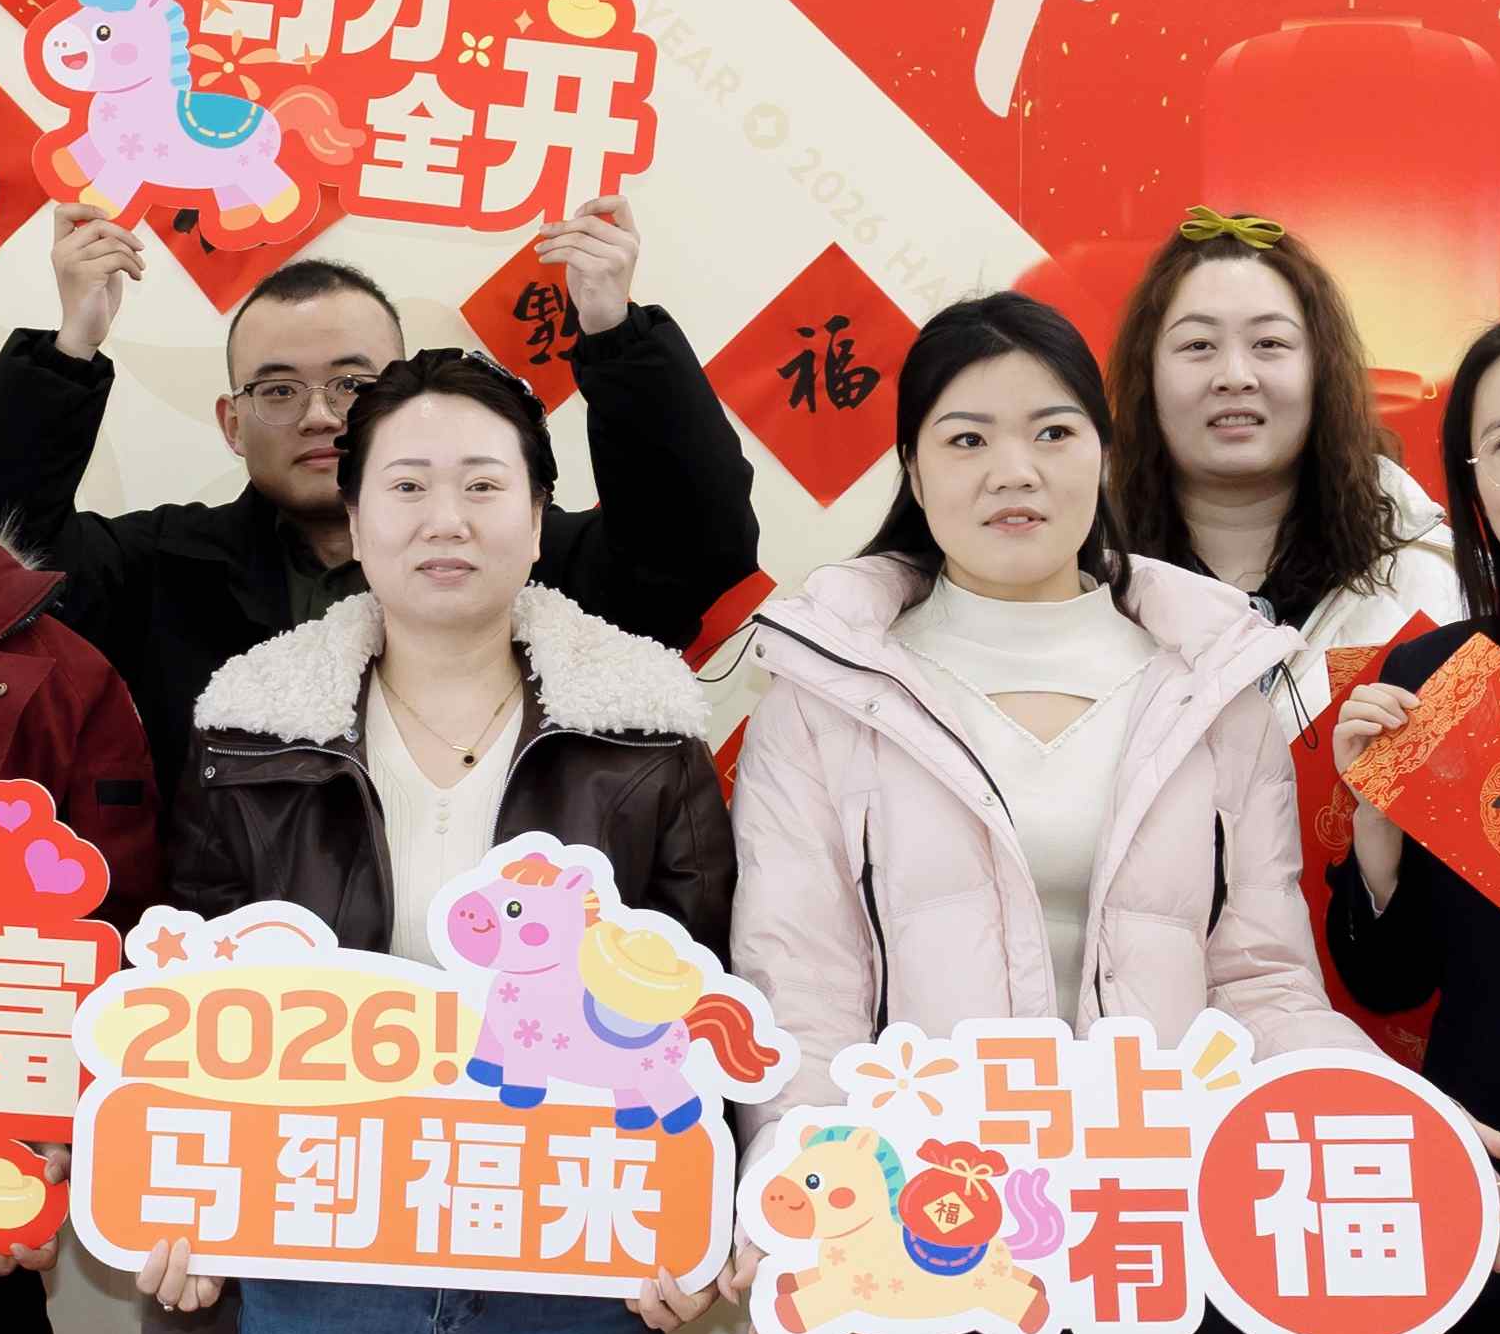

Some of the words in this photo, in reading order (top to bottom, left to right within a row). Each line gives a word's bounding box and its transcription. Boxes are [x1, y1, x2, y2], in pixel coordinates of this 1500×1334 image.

[777, 314, 882, 414] 福
[121, 986, 461, 1087] 2026!
[139, 1105, 664, 1267] 马到福来
[933, 1200, 961, 1227] 福
